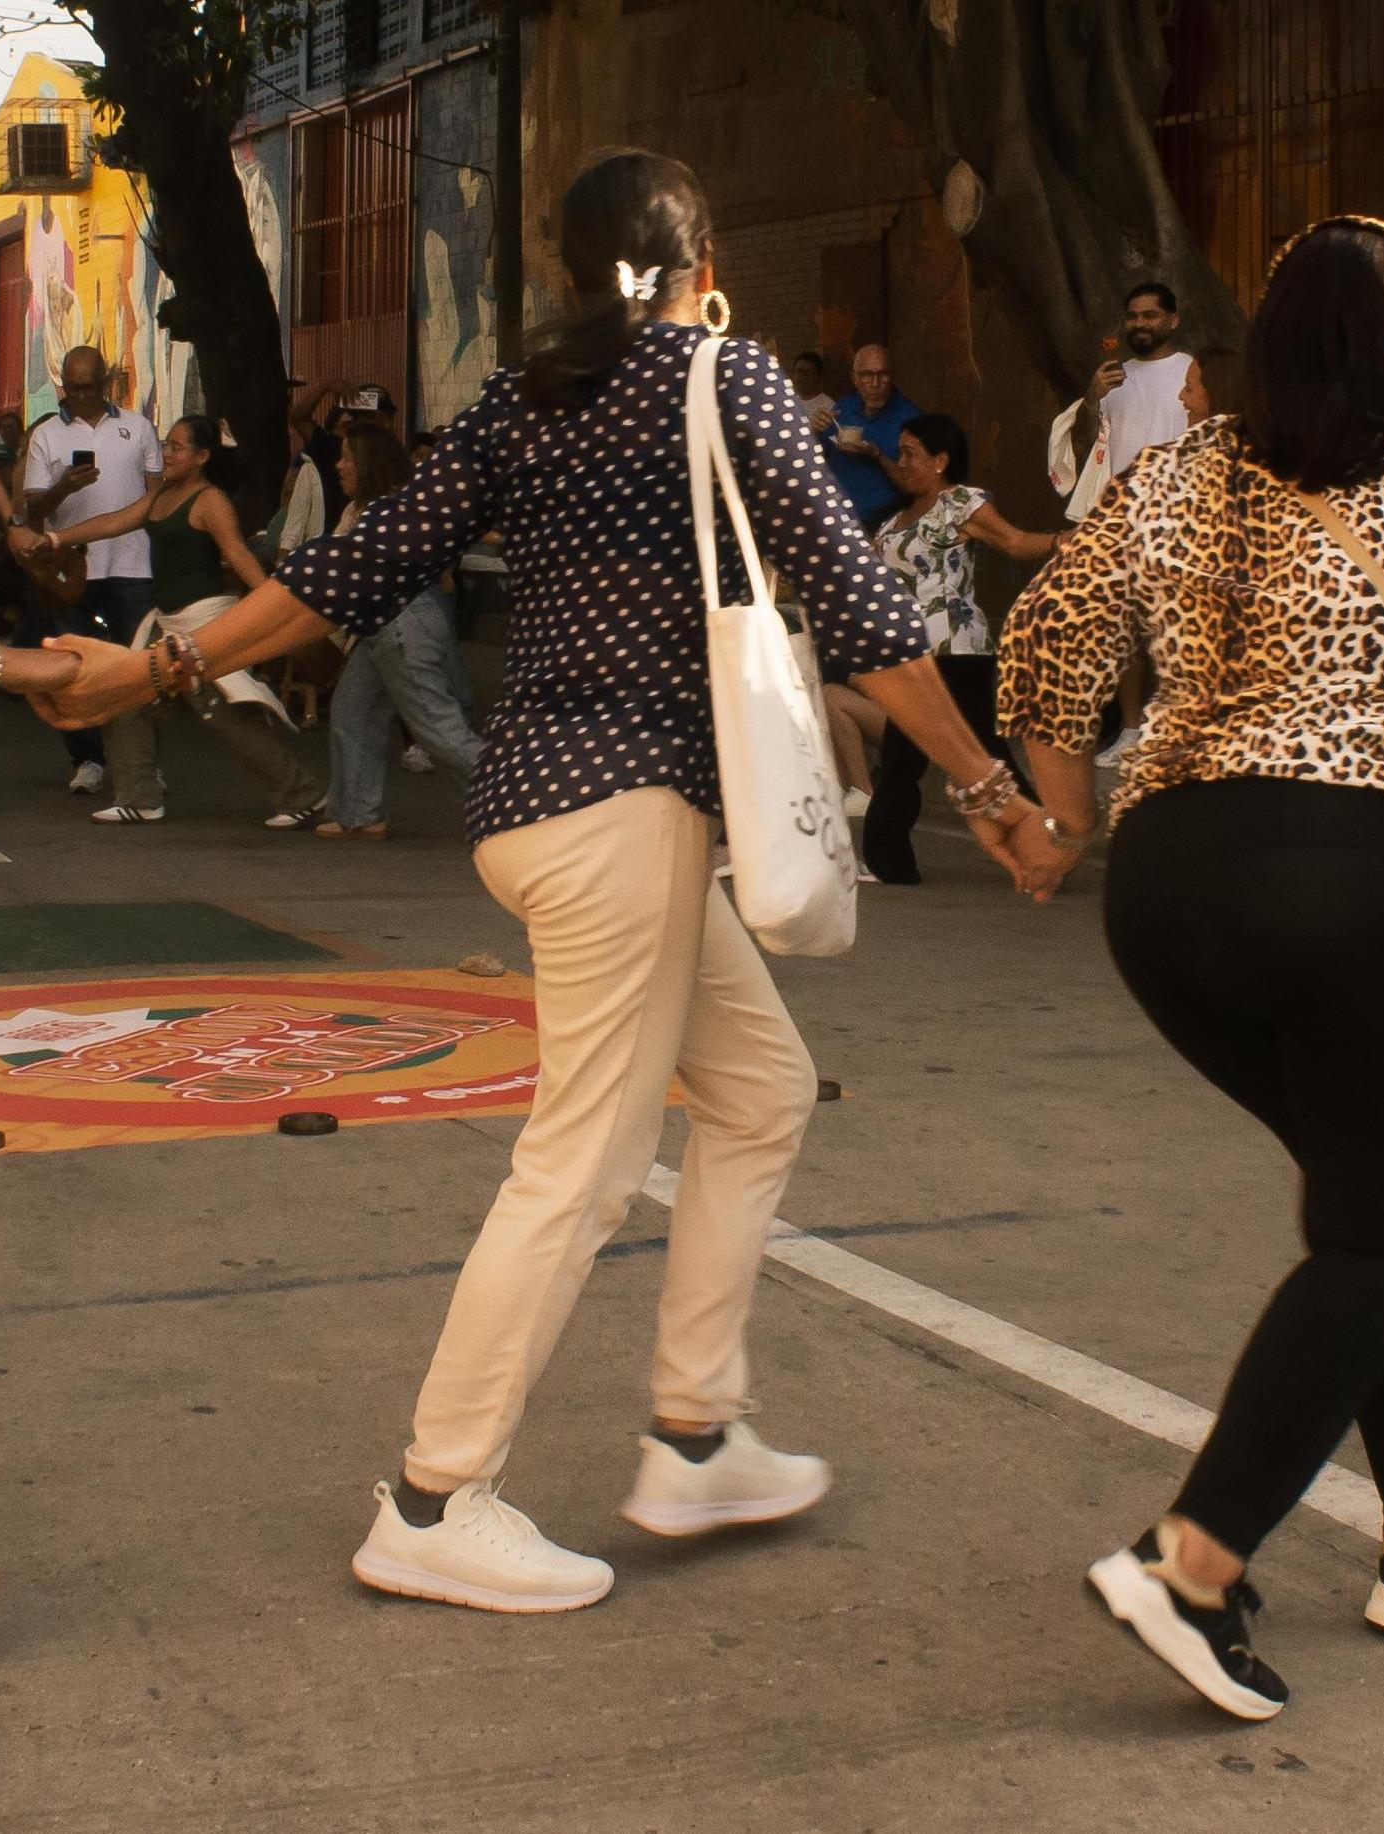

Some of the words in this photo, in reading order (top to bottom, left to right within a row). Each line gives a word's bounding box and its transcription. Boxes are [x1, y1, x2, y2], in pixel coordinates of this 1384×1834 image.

[8, 1002, 337, 1082] ESTOY
[165, 1014, 517, 1103] JUGADA
[198, 1047, 268, 1067] EN
[260, 1029, 333, 1045] LA
